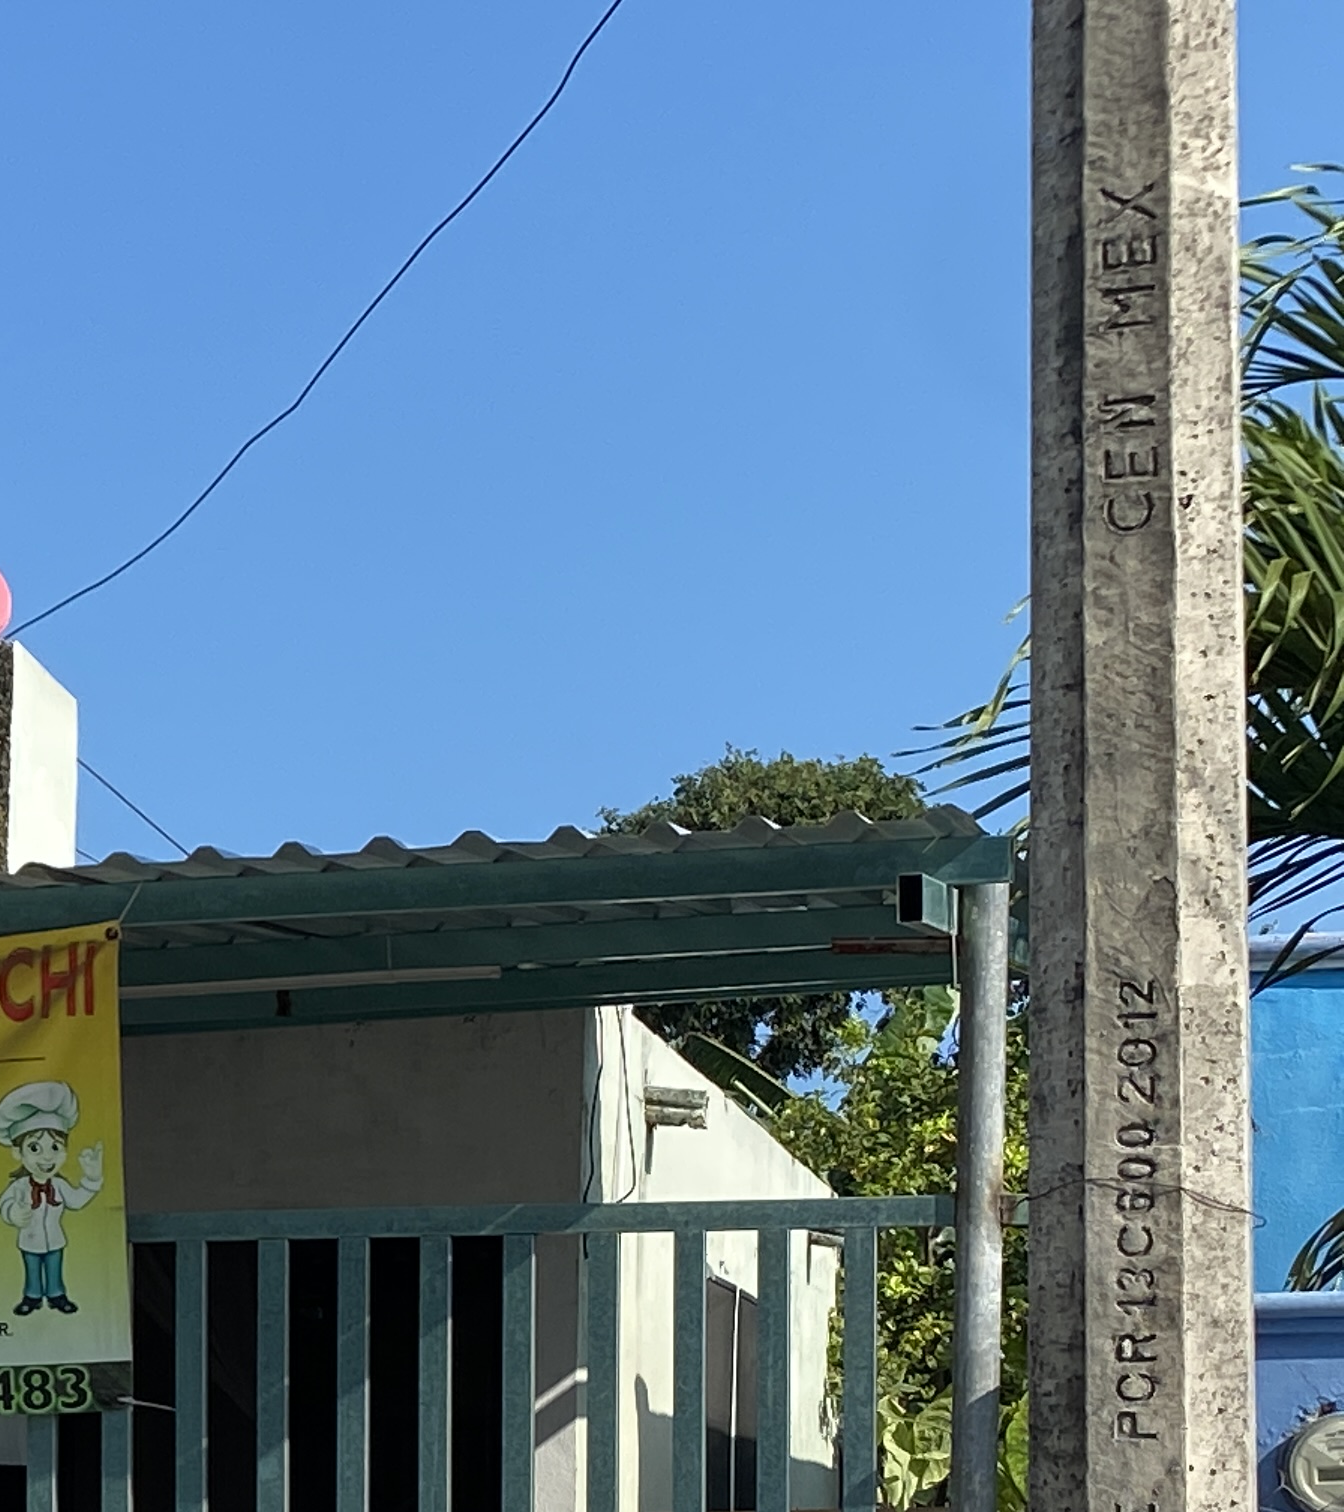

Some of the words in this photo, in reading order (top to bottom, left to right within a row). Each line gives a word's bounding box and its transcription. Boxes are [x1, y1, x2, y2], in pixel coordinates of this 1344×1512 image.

[1098, 181, 1160, 334] MEX
[1116, 979, 1160, 1105] 2012
[1113, 1333, 1160, 1438] PCR
